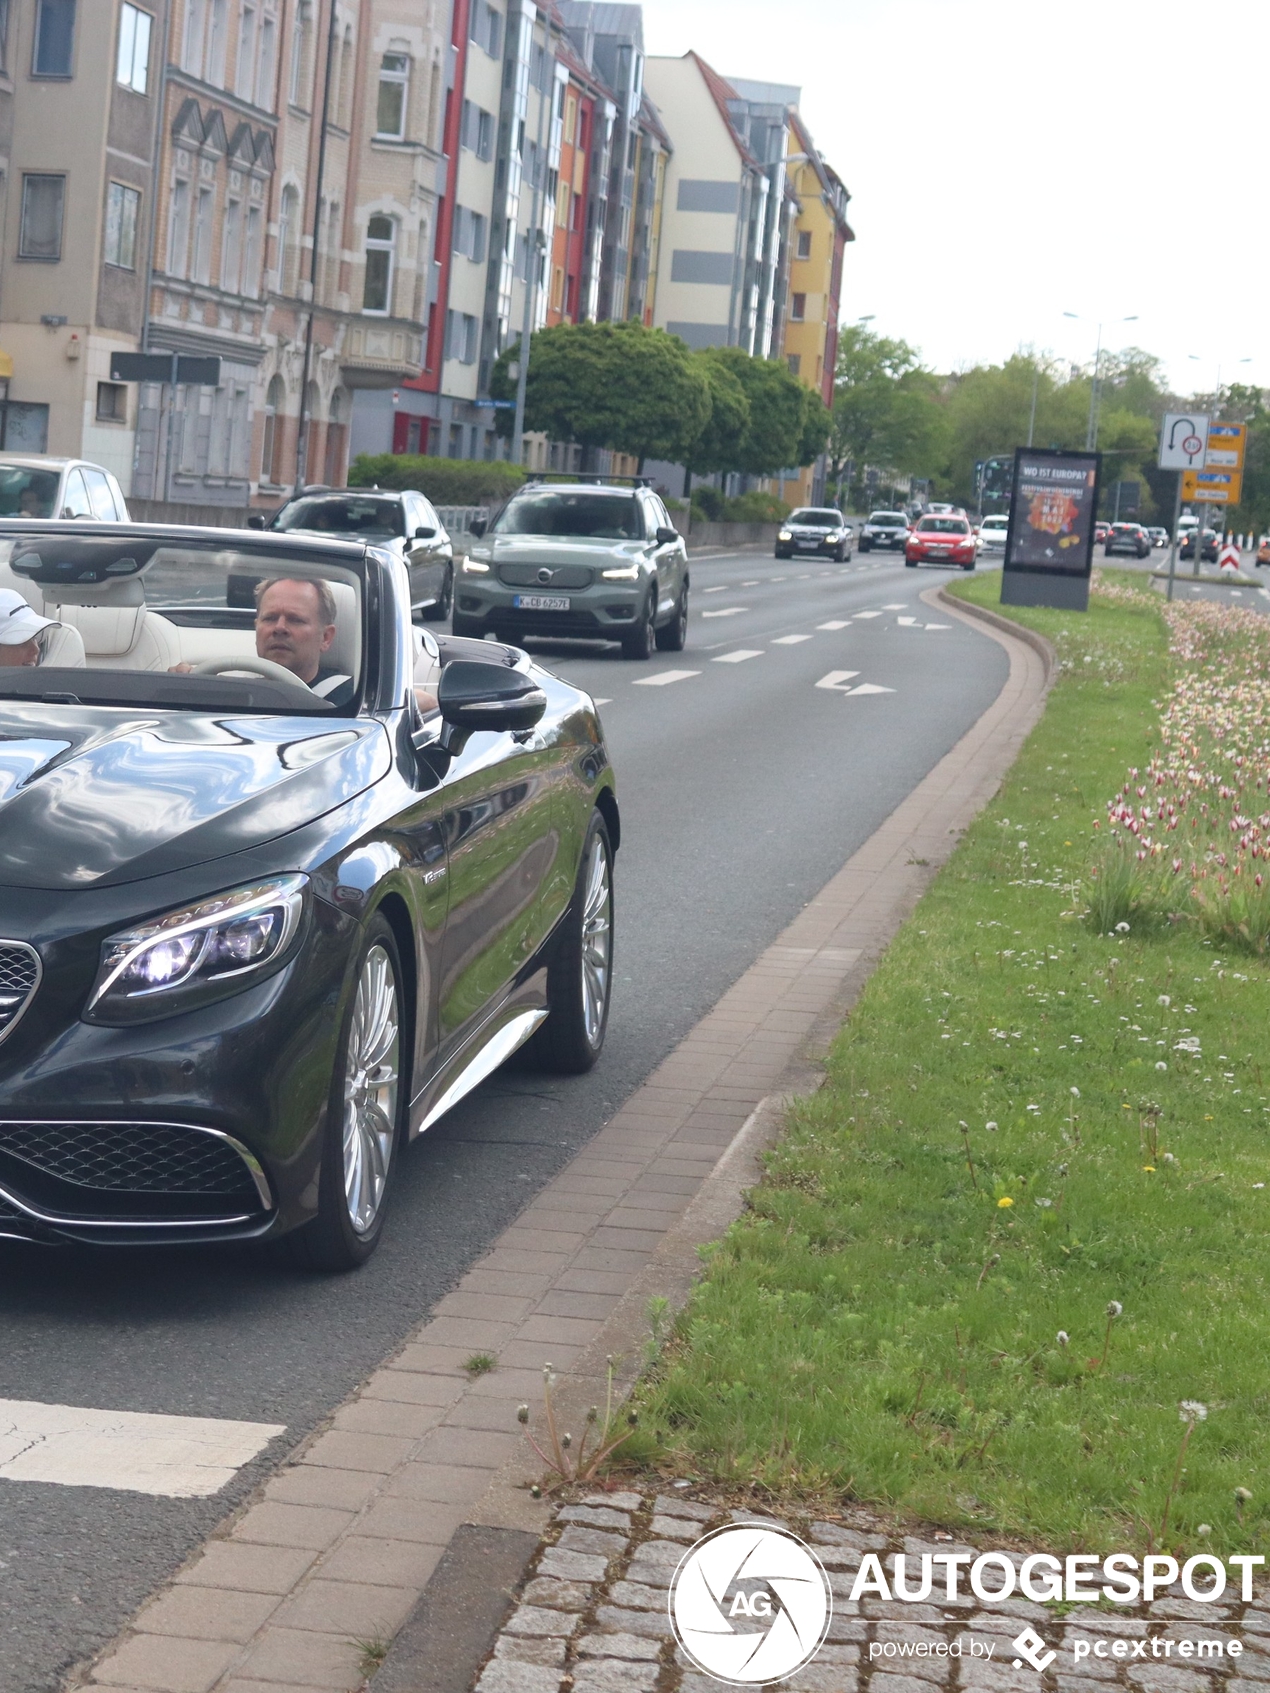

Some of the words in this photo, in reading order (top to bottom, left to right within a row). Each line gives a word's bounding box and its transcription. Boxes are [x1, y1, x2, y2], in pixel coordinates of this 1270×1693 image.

[1024, 467, 1037, 476] WO
[1039, 468, 1050, 477] IST
[1052, 469, 1087, 479] EUROPA?
